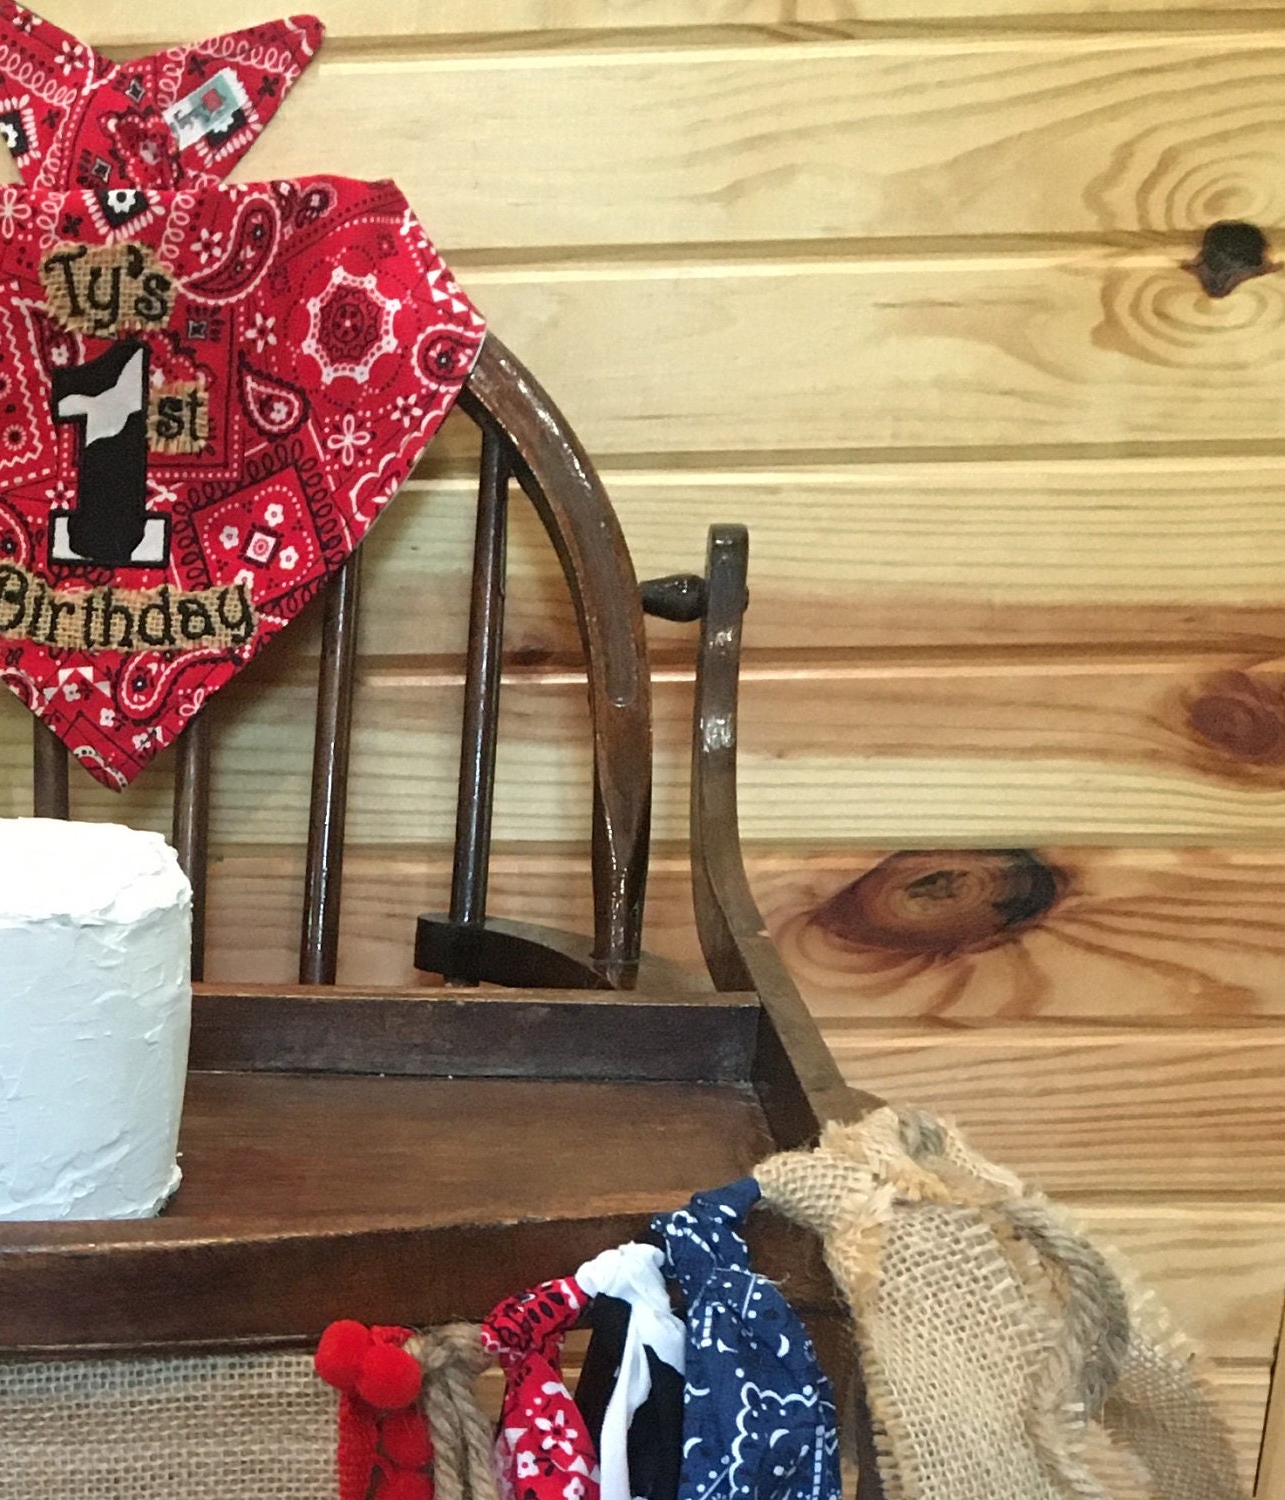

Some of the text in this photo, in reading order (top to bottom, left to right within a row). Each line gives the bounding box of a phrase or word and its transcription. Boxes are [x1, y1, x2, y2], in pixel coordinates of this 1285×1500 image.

[45, 246, 172, 331] Ty's
[50, 339, 206, 567] 1 st
